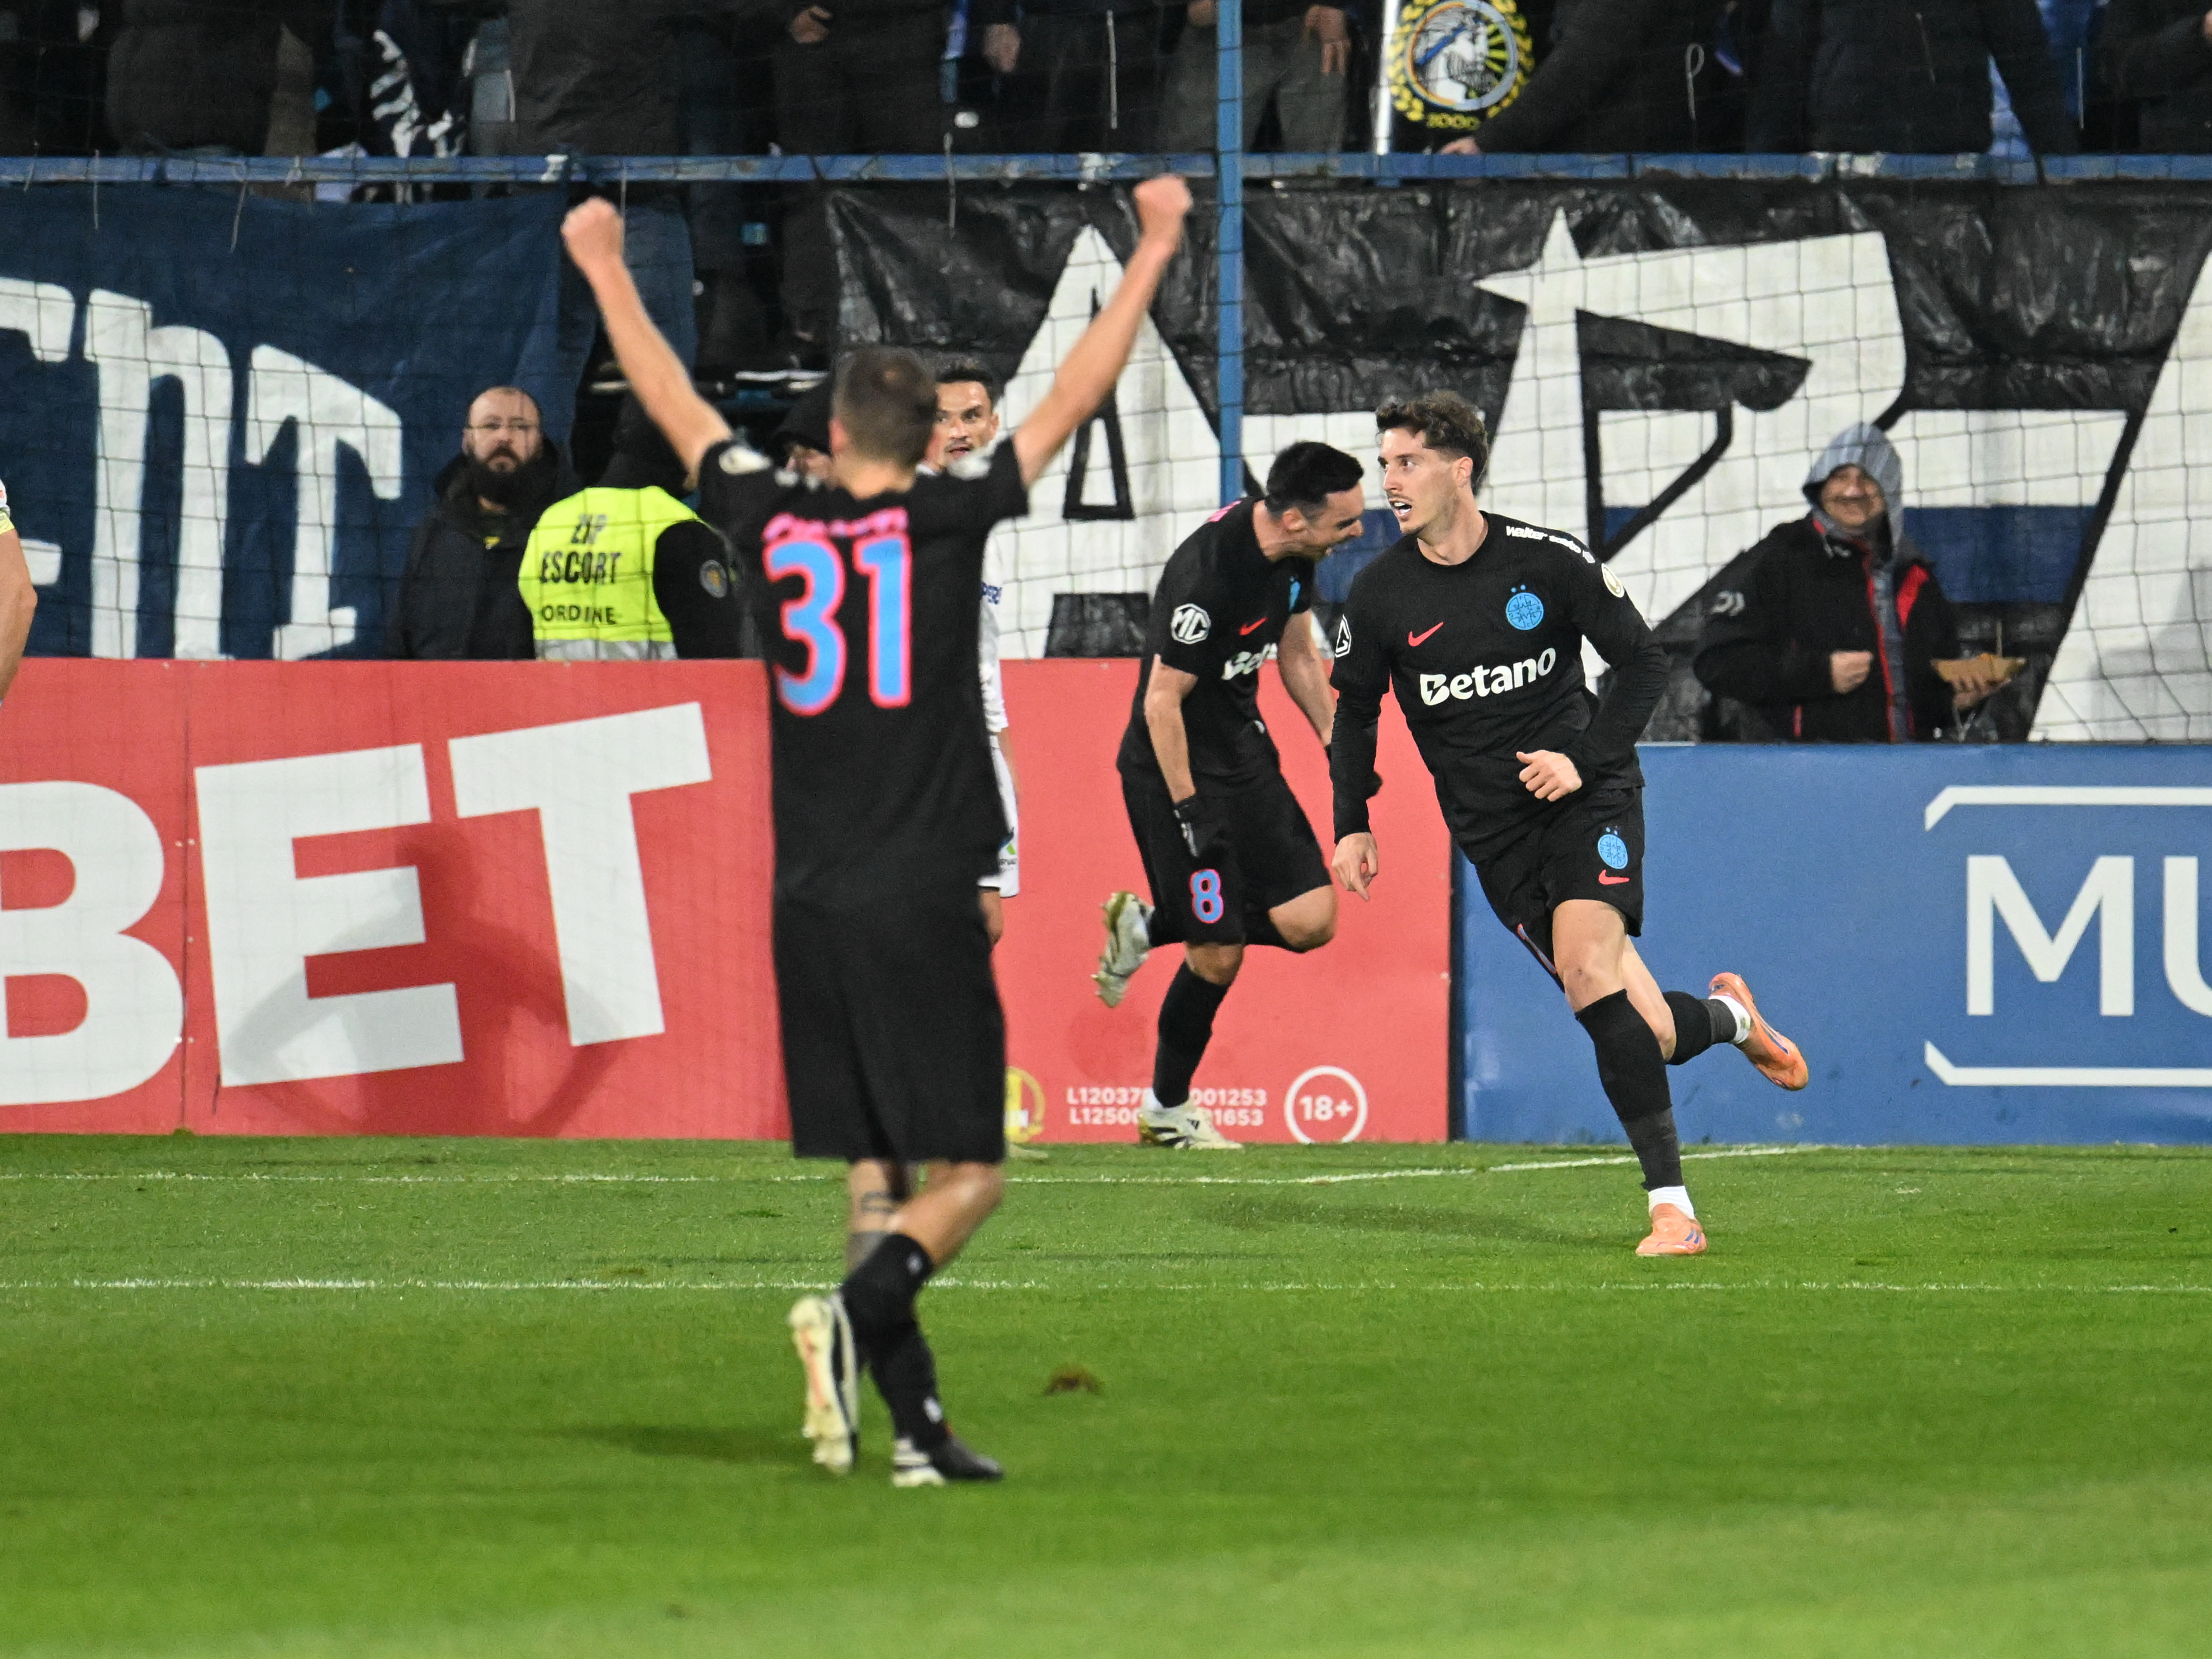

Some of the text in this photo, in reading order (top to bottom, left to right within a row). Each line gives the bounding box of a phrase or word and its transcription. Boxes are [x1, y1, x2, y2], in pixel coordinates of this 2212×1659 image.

[539, 551, 622, 584] ESCORT
[541, 604, 618, 625] ORDINE
[762, 533, 912, 717] 31
[1419, 647, 1556, 706] Betano
[0, 701, 713, 1106] BET
[1190, 868, 1224, 924] 8
[1299, 1095, 1353, 1121] 18+
